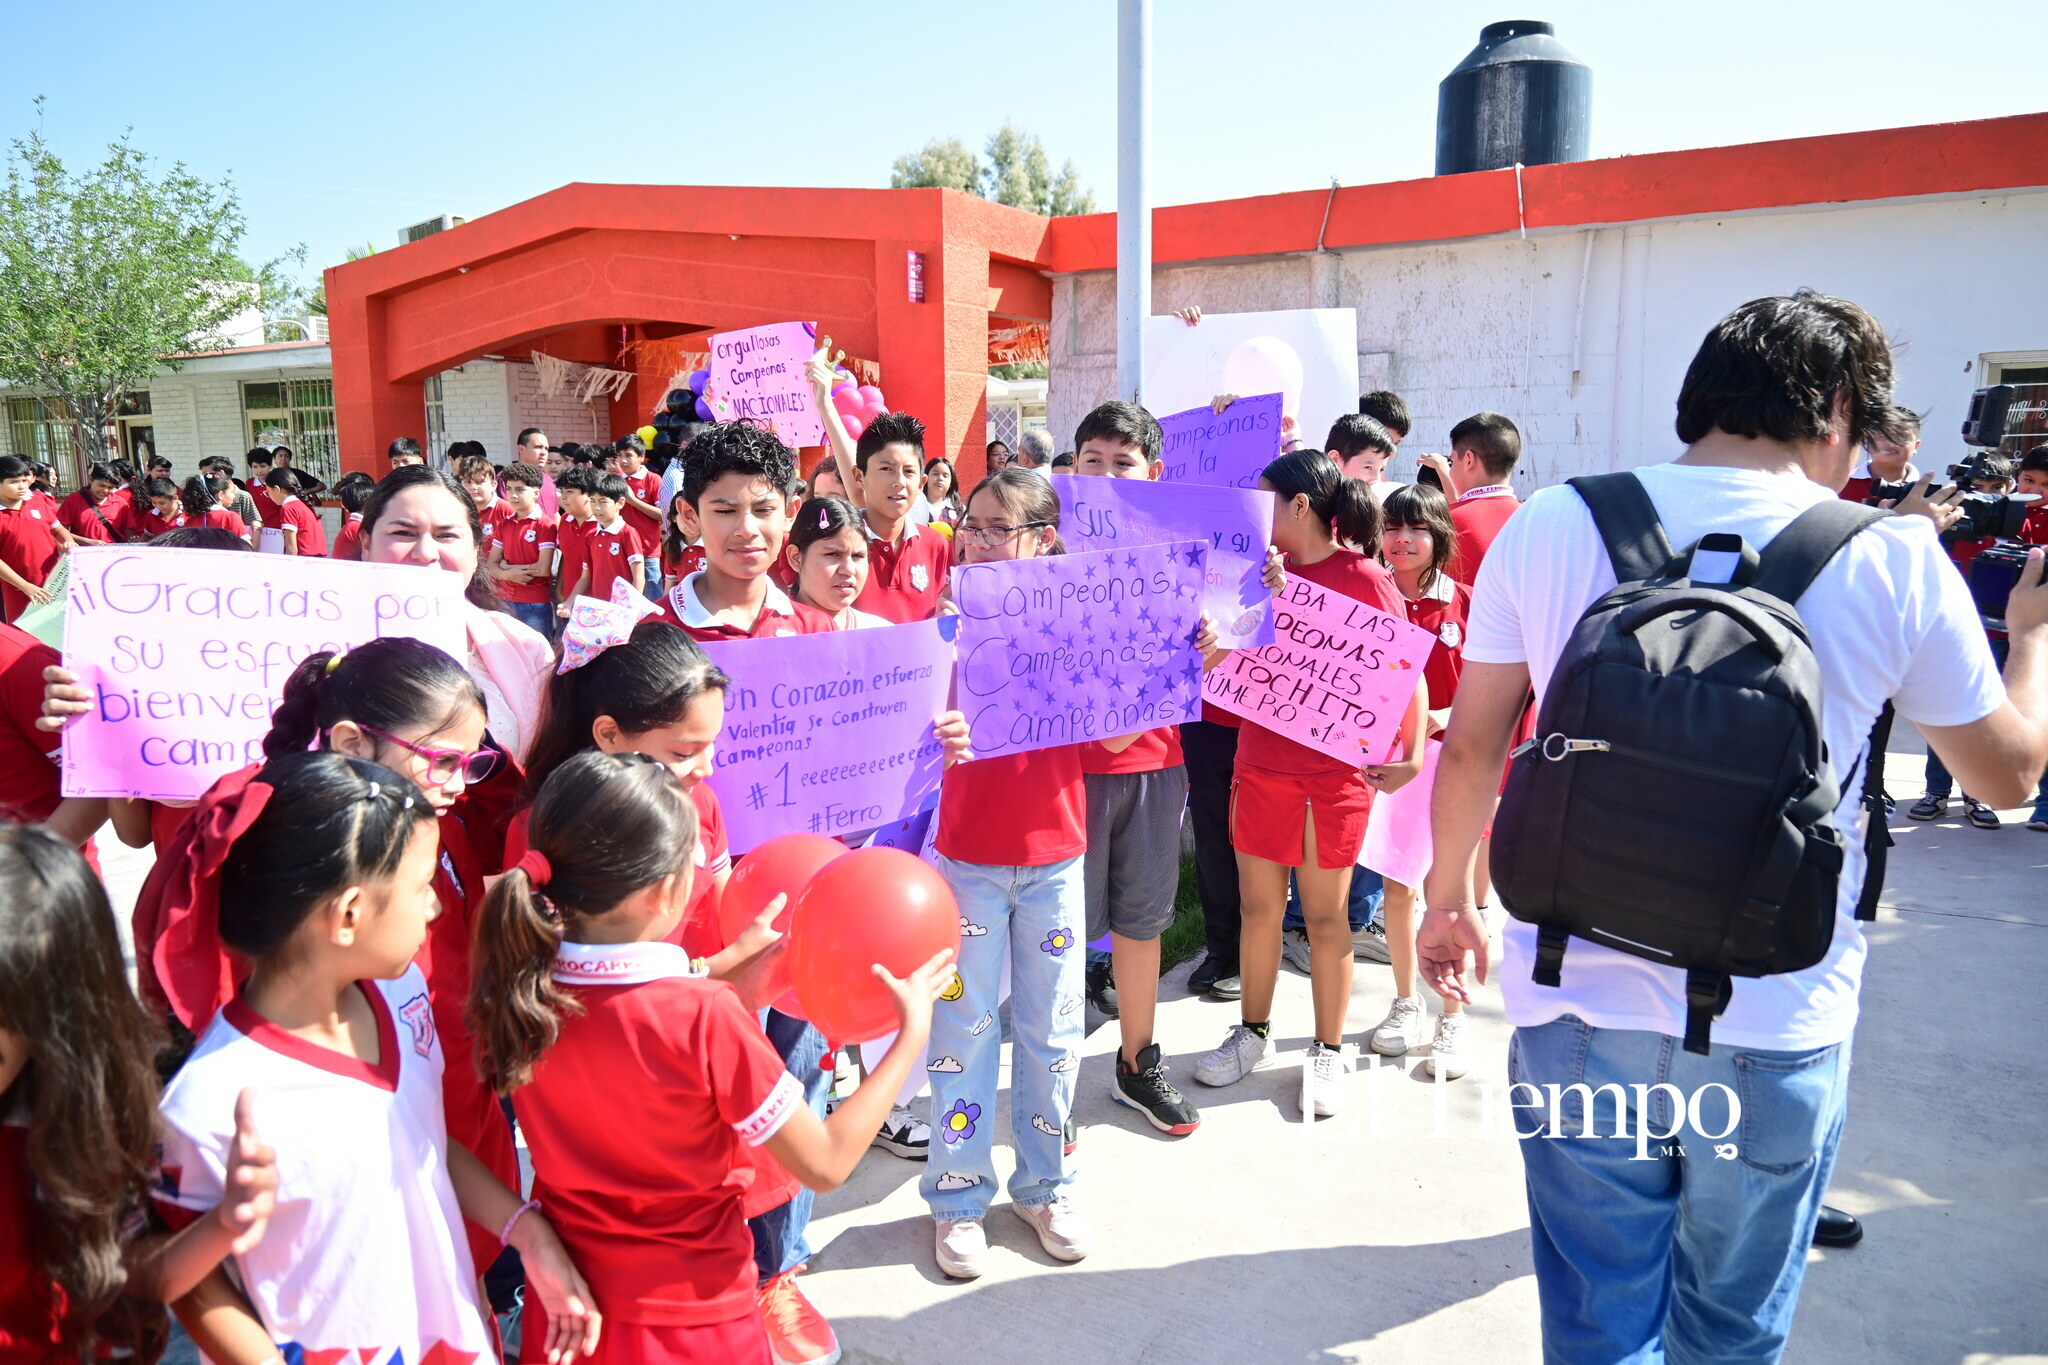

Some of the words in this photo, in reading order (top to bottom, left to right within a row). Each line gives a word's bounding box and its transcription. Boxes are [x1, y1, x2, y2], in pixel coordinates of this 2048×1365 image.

[732, 392, 805, 419] NACIONALES
[1163, 411, 1270, 454] ampeonas
[1161, 463, 1186, 482] ara
[1198, 449, 1218, 477] la
[959, 565, 1170, 620] Campeonas
[1204, 568, 1223, 586] ón
[374, 594, 455, 638] por
[1275, 579, 1328, 612] IBA
[1343, 604, 1396, 643] LAS
[964, 636, 1156, 697] Campeonas
[1241, 645, 1364, 696] IONALES
[1233, 650, 1377, 730] TOCHITO
[968, 699, 1175, 753] Campeonas
[141, 736, 267, 767] camp
[807, 802, 882, 833] #Ferro
